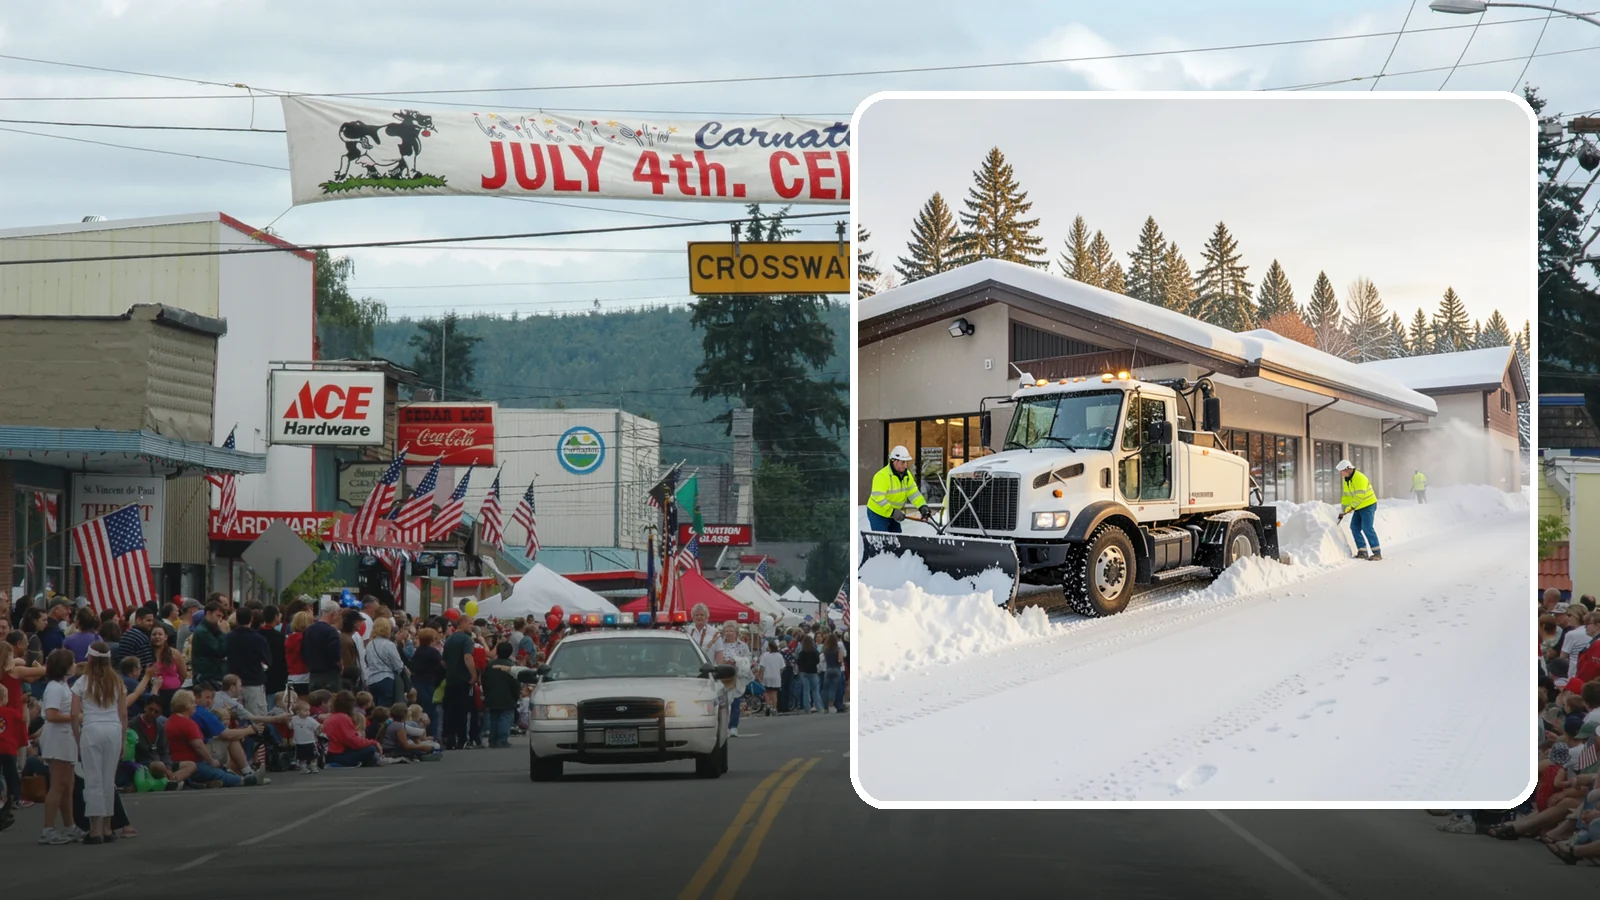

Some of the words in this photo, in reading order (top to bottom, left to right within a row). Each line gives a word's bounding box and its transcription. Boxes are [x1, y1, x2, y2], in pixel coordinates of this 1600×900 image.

[481, 141, 605, 193] JULY
[632, 149, 746, 198] 4th.
[697, 254, 850, 280] CROSSWA
[283, 380, 374, 420] ACE
[406, 409, 452, 422] CEDAR
[461, 409, 485, 422] LOG
[283, 421, 371, 437] Hardware
[83, 485, 94, 494] St.
[96, 485, 124, 495] Vincent
[126, 485, 136, 495] de
[138, 486, 155, 495] Paul
[213, 515, 331, 535] HARDARE
[688, 527, 742, 535] CRNATION
[699, 535, 730, 543] GLASS
